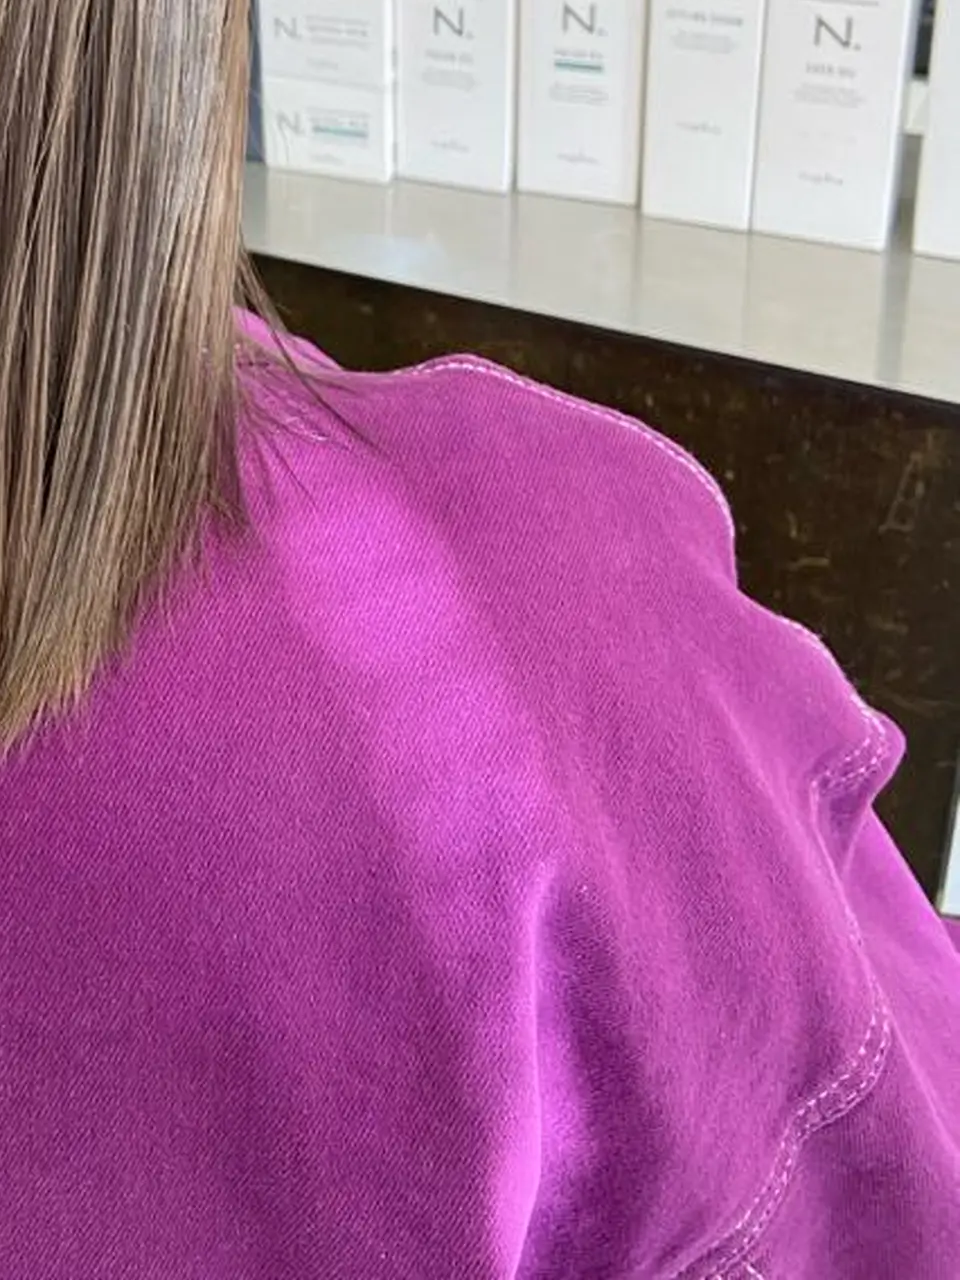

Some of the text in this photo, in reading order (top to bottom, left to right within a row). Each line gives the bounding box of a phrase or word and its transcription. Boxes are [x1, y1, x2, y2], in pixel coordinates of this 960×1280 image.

[433, 6, 474, 40] N.
[562, 2, 608, 37] N.
[814, 14, 861, 52] N.
